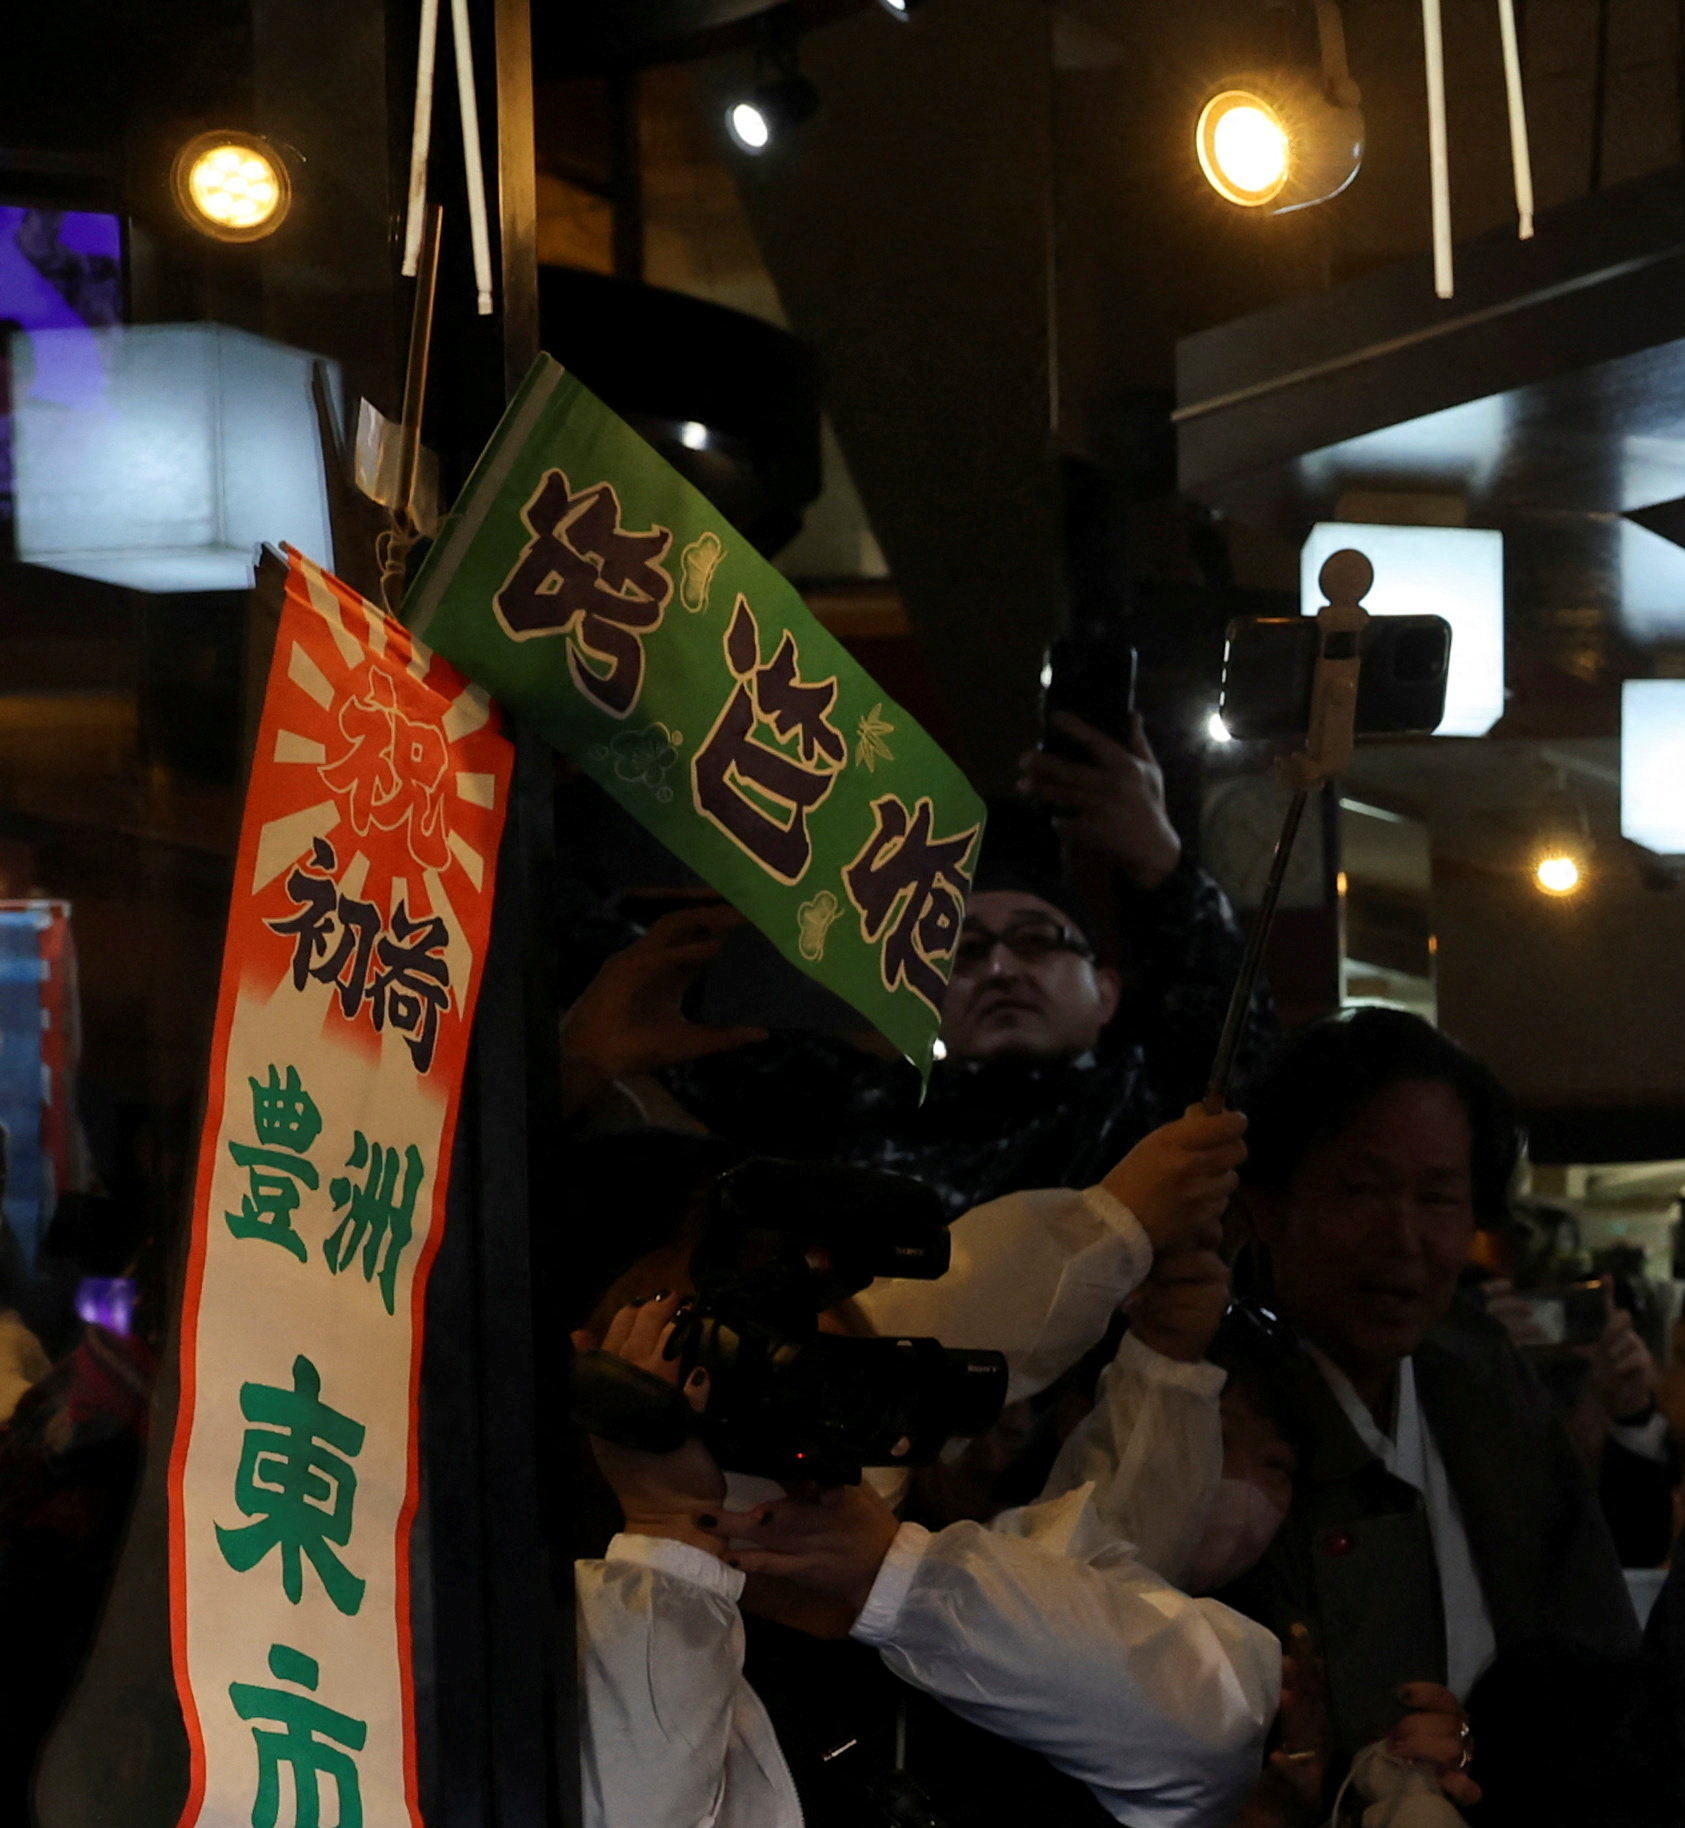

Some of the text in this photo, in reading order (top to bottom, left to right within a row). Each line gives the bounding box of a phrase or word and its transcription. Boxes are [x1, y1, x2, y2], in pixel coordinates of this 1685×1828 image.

[317, 664, 453, 873] 祝
[262, 836, 450, 1076] 初荷
[225, 1065, 426, 1316] 豊洲
